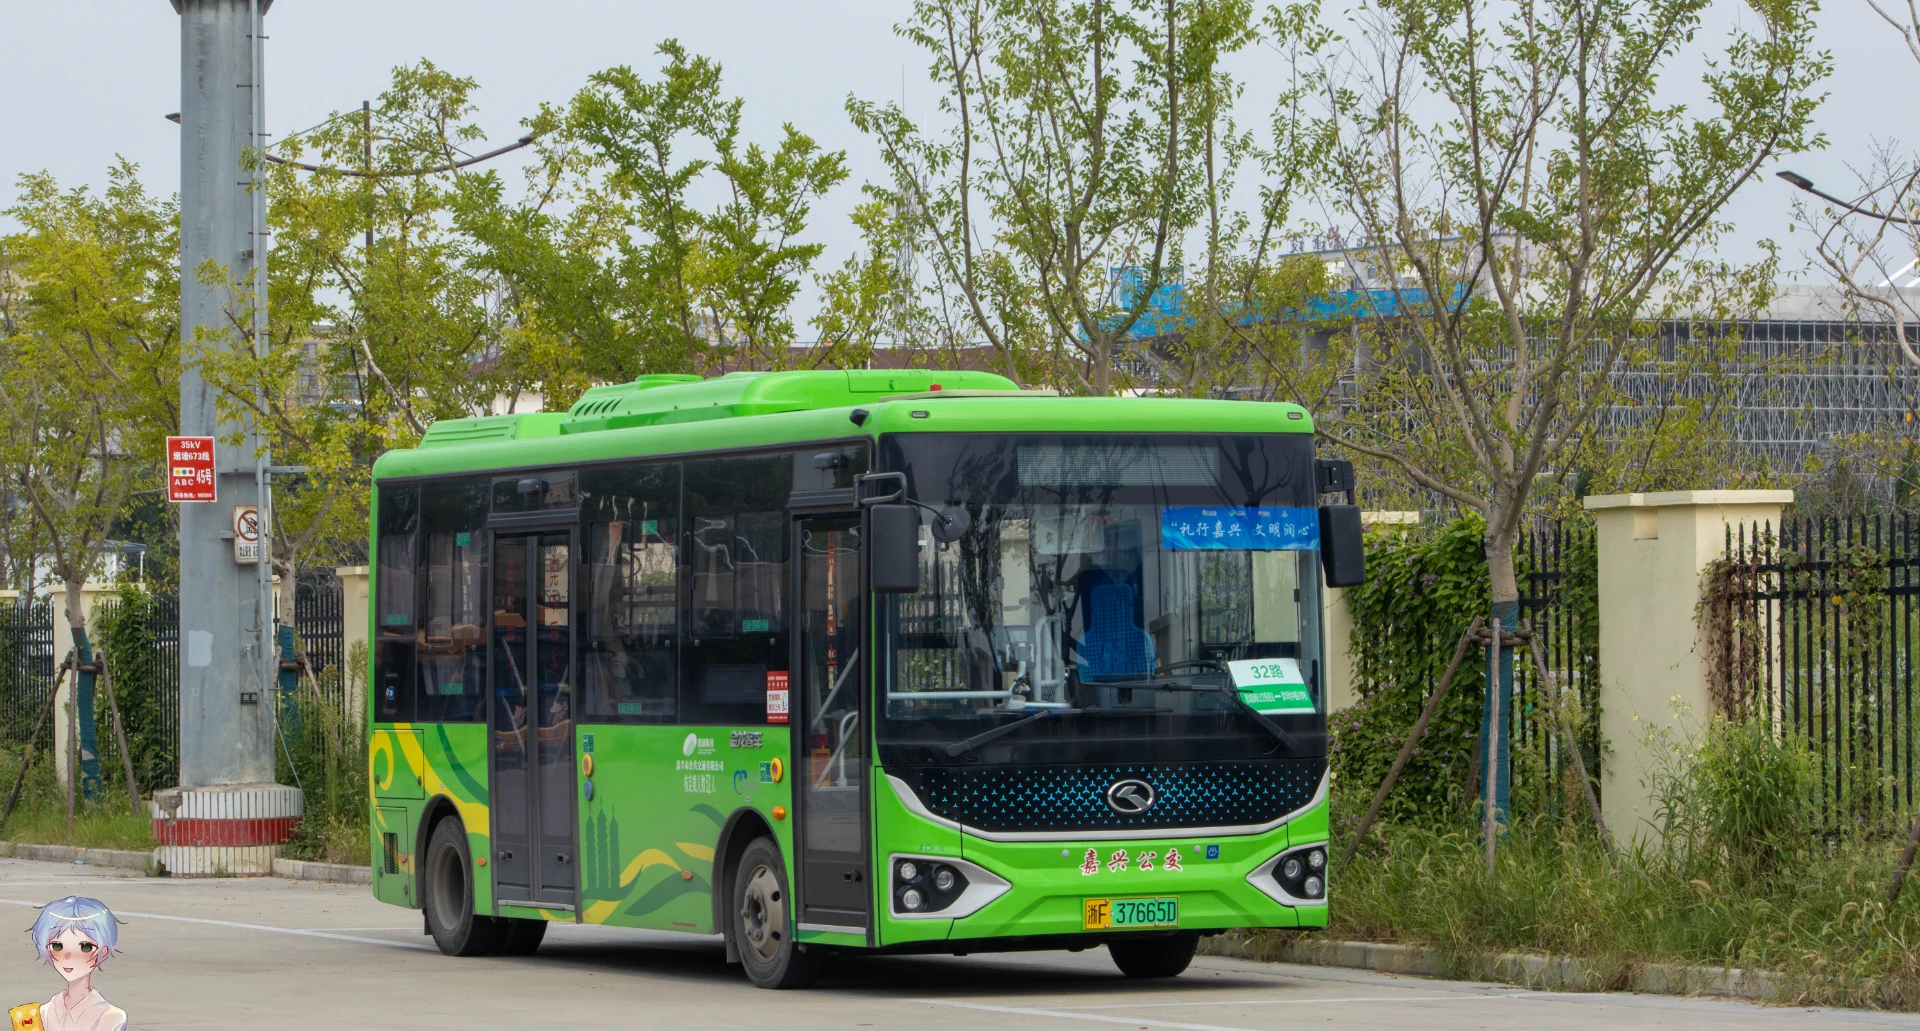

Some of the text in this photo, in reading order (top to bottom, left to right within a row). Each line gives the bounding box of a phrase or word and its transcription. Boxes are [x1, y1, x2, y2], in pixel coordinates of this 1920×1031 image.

[181, 441, 201, 449] 35kV
[196, 468, 212, 485] 45号
[1251, 664, 1284, 679] 32路
[729, 730, 763, 748] 金龙客车
[1079, 848, 1183, 876] 嘉兴公交
